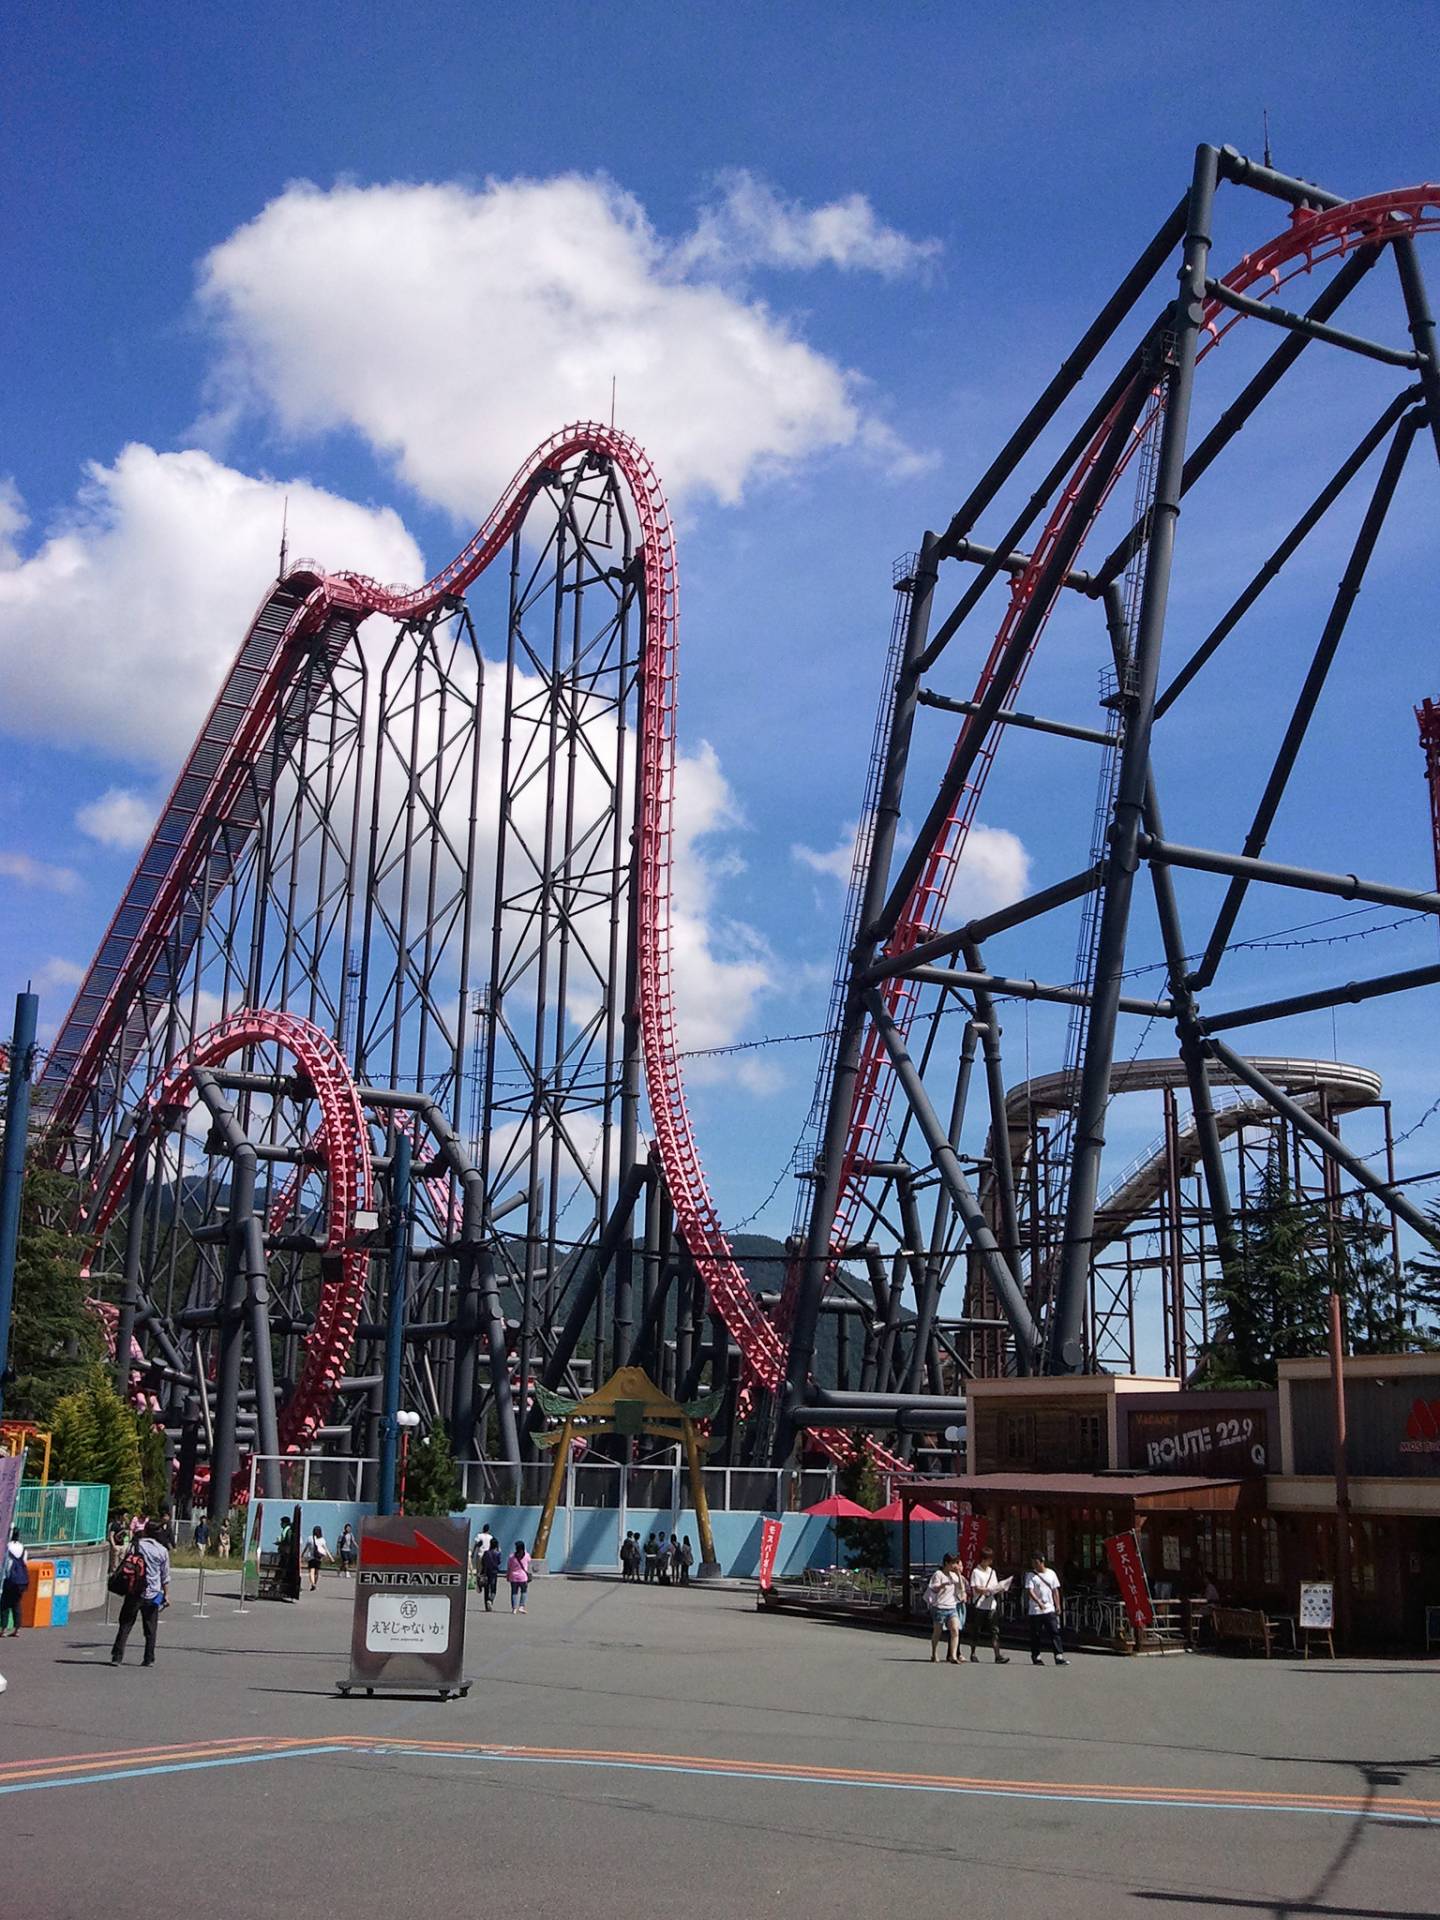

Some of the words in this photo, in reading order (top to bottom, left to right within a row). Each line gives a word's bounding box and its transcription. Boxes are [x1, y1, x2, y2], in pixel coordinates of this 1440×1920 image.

[1147, 1426, 1212, 1466] ROUTE
[1216, 1418, 1253, 1447] 229
[1400, 1441, 1423, 1453] MOS
[1251, 1444, 1265, 1465] Q
[359, 1571, 461, 1586] ENTRANCE
